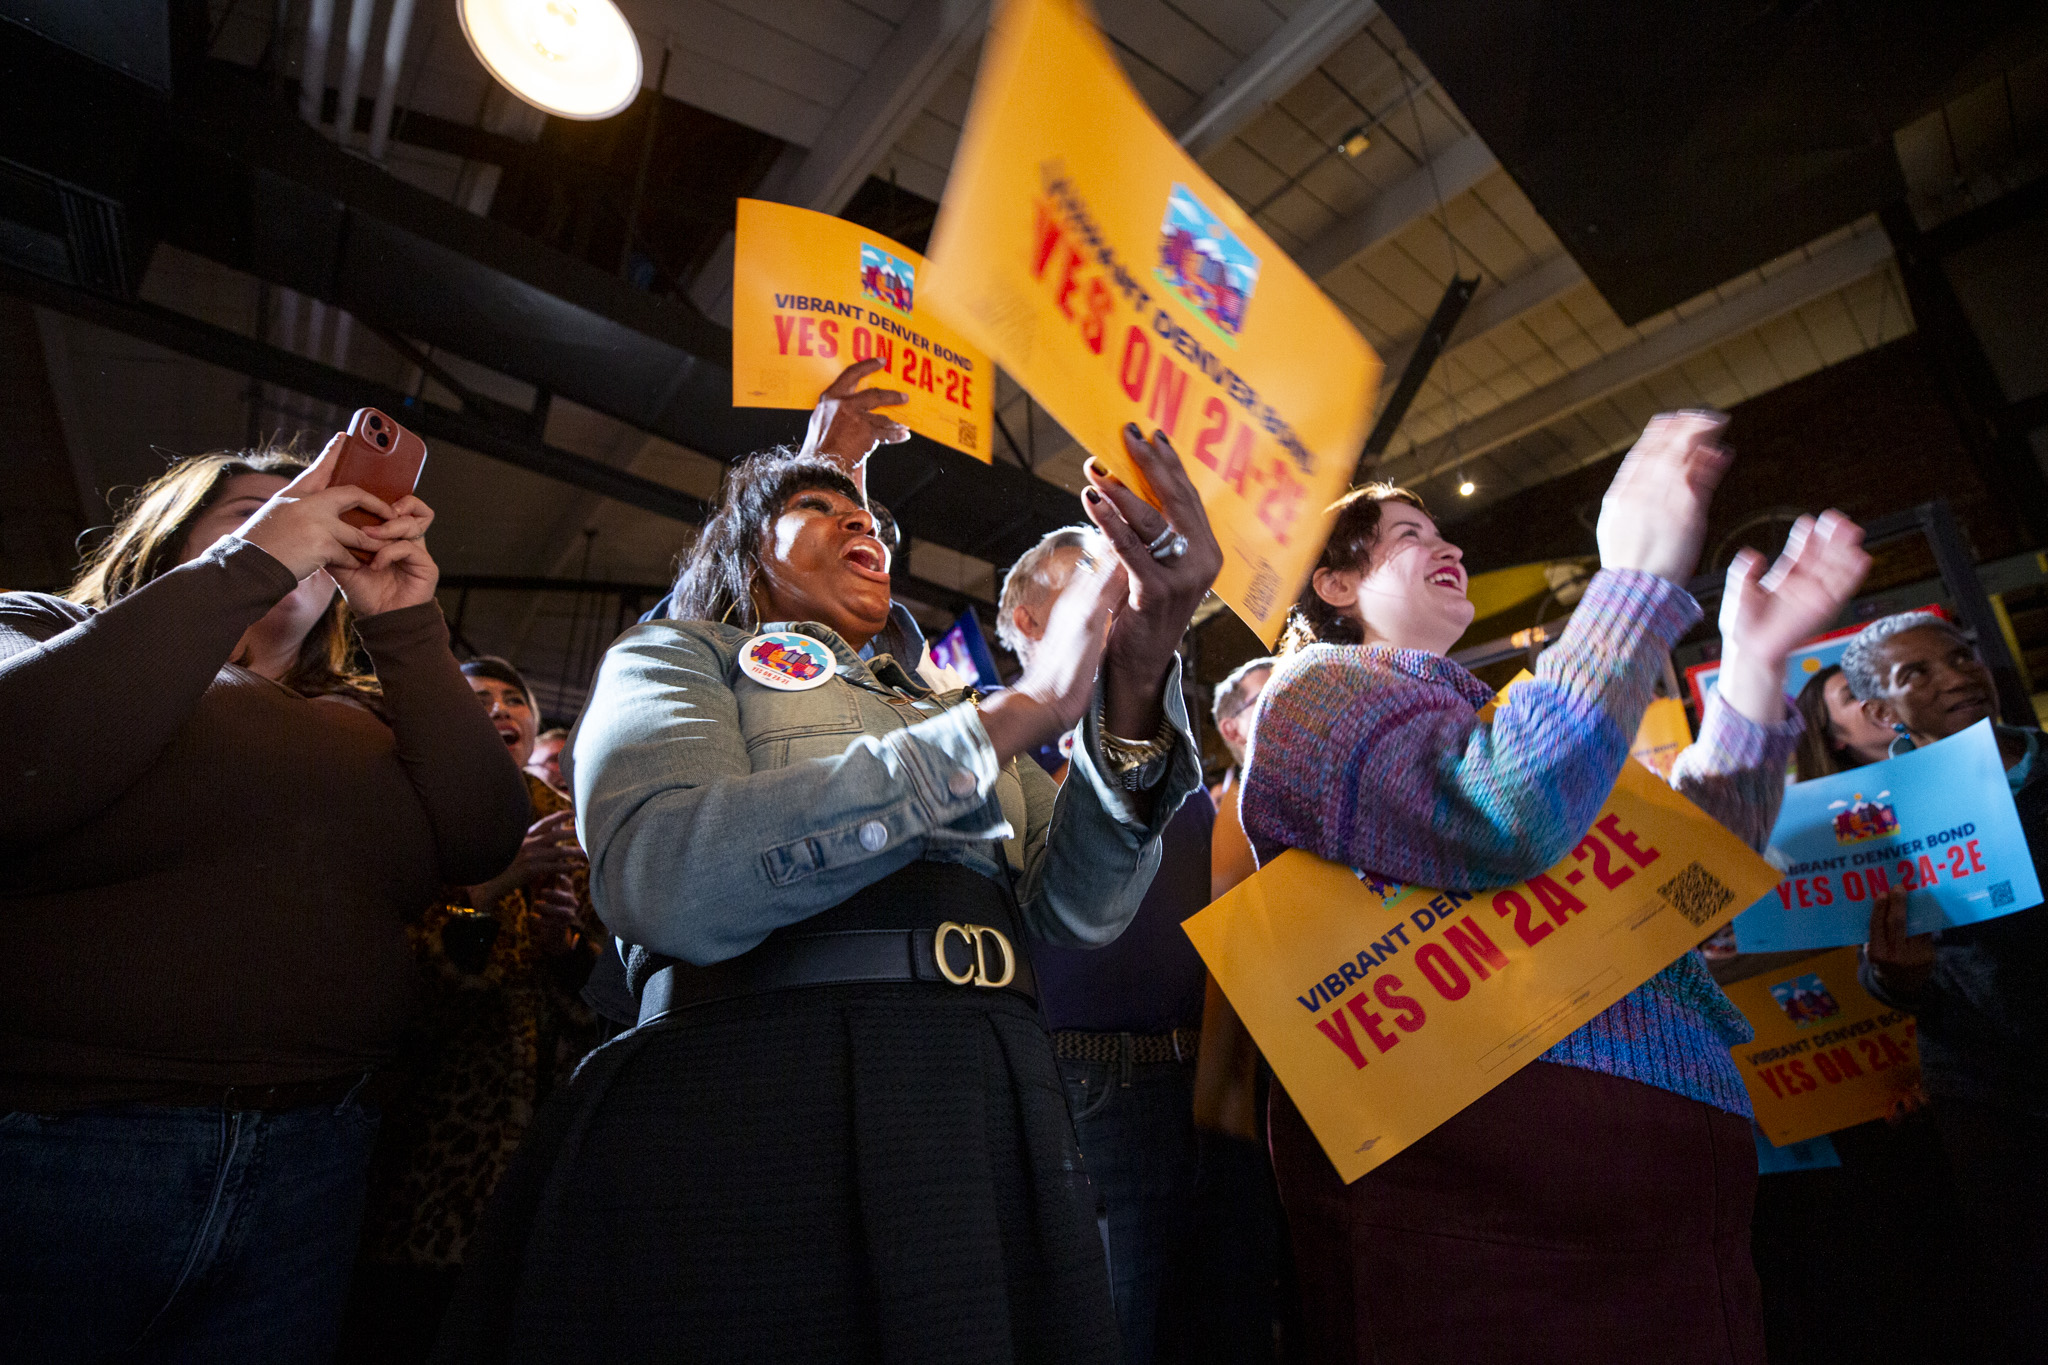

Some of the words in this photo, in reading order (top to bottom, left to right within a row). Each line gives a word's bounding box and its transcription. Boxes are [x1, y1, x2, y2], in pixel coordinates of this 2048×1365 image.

[774, 293, 864, 320] VIBRANT
[869, 311, 930, 349] DENVER
[934, 341, 974, 372] BOND
[1030, 194, 1116, 358] YES
[1118, 324, 1191, 438] ON
[774, 314, 839, 359] YES
[852, 326, 893, 374] ON
[902, 347, 973, 410] 2A-2E
[1776, 875, 1834, 910] YES
[1842, 866, 1890, 901] ON
[1896, 838, 1987, 893] 2A-2E
[1787, 855, 1847, 876] BRANT
[1853, 838, 1924, 867] DENVER
[1926, 822, 1976, 848] BOND
[935, 921, 1016, 988] CD
[1296, 922, 1410, 1014] VIBRANT
[1410, 889, 1475, 933] DEN
[1315, 973, 1427, 1071] YES
[1413, 916, 1511, 1003] ON
[1491, 812, 1661, 948] 2A-2E
[1758, 1059, 1817, 1099] YES
[1813, 1046, 1863, 1084] ON
